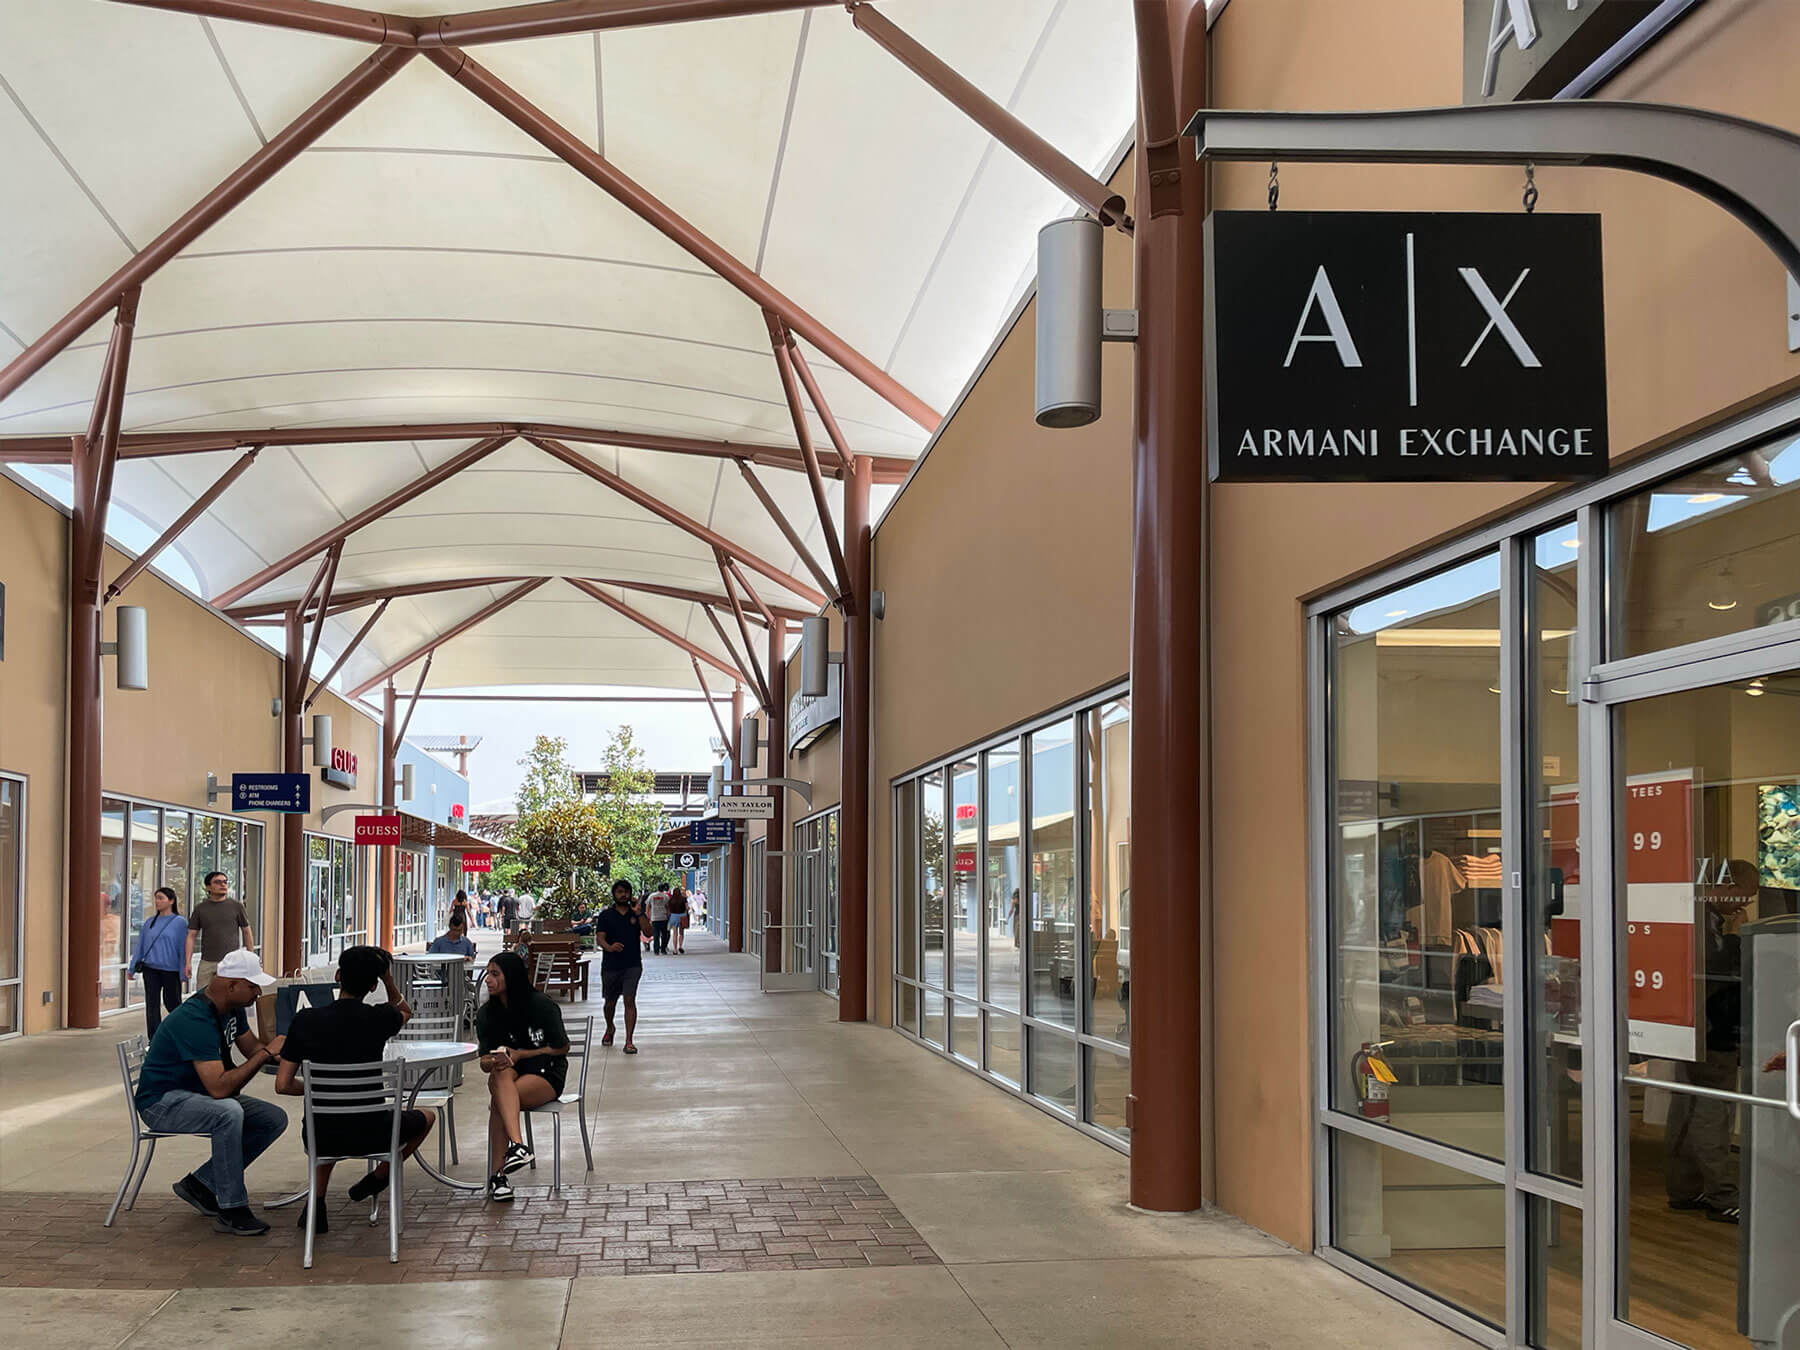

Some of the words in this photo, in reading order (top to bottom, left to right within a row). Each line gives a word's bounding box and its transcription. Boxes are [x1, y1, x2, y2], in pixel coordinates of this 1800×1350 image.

[1237, 429, 1379, 456] ARMANI
[1400, 429, 1593, 456] EXCHANGE
[1631, 785, 1663, 798] TEES
[356, 825, 399, 836] GUESS
[463, 859, 490, 867] GUESS
[422, 1001, 439, 1009] LITTER
